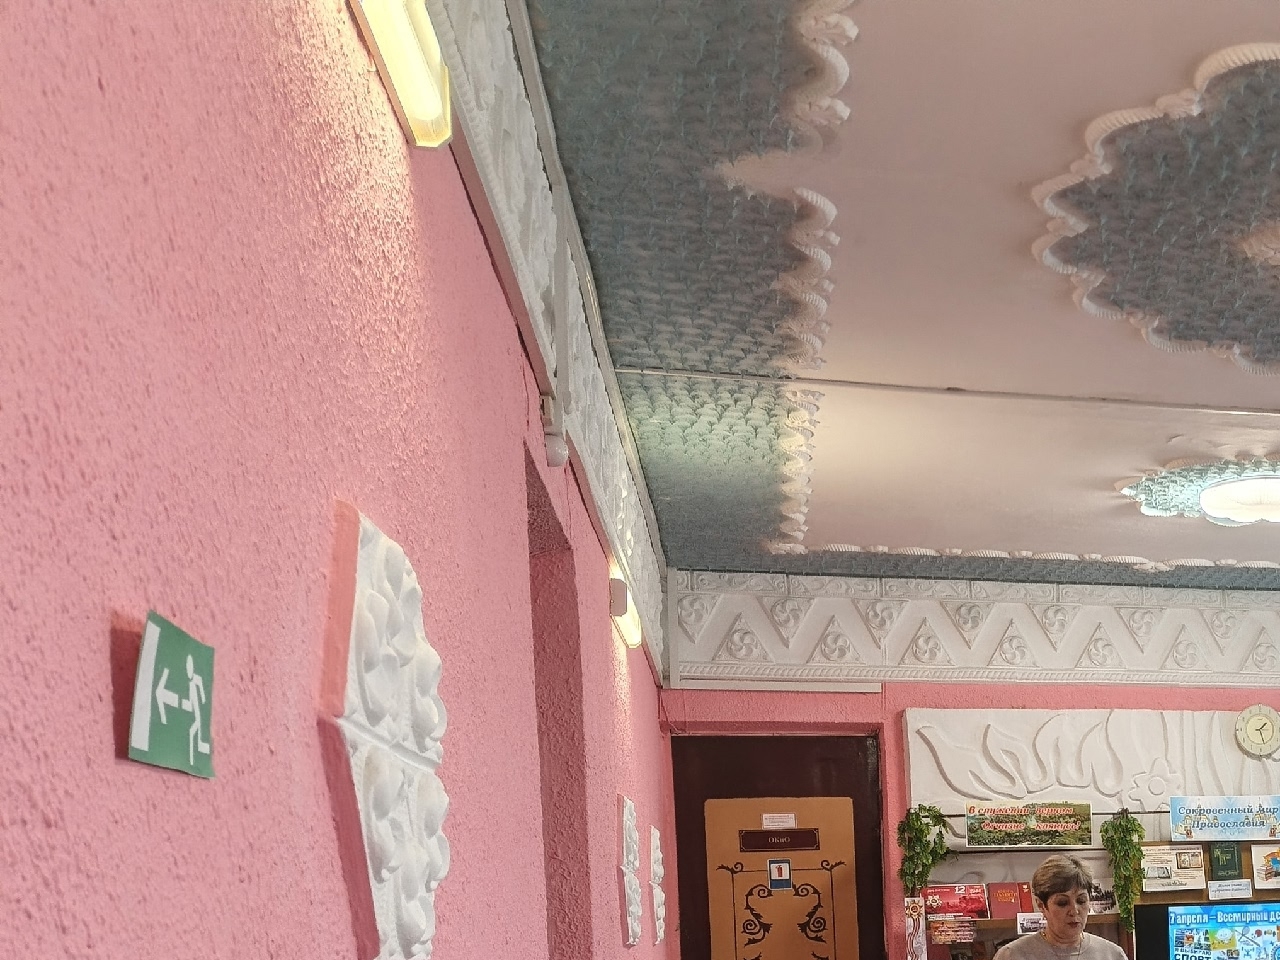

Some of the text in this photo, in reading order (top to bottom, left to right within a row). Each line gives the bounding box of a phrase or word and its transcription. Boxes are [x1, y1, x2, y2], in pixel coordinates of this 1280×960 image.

[967, 805, 976, 814] В
[978, 806, 1030, 815] служении
[1178, 805, 1279, 816] Сокровенный мир
[1191, 819, 1266, 830] Православия
[954, 886, 966, 894] 12
[1170, 914, 1175, 925] 7
[1176, 912, 1209, 926] апреля
[1217, 909, 1269, 923] Всемирный
